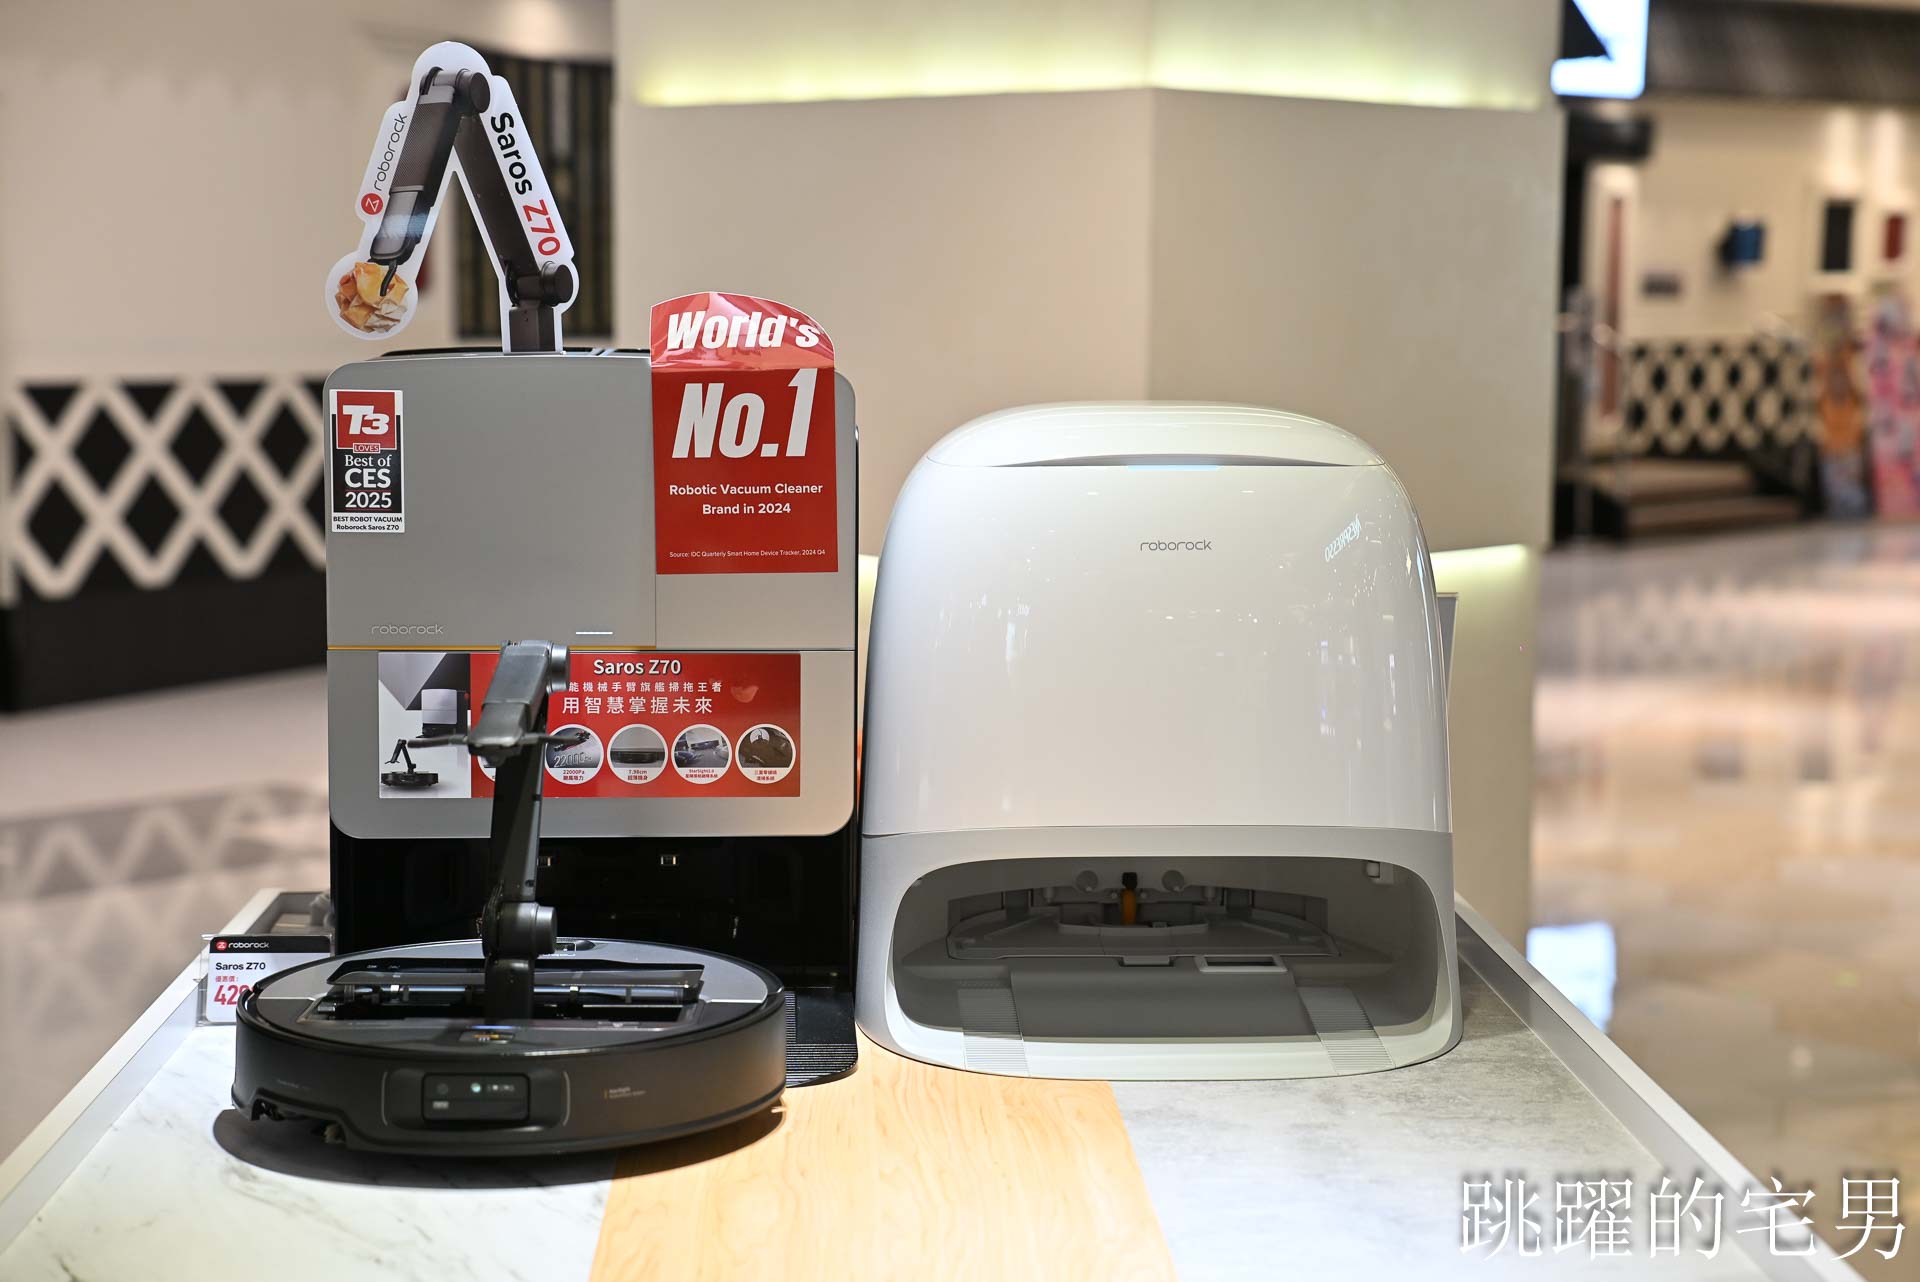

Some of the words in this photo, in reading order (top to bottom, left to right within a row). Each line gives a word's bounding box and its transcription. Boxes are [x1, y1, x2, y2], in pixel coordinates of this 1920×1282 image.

[374, 112, 408, 191] roborock
[490, 112, 533, 195] Saros
[522, 199, 561, 257] Z70
[667, 311, 820, 350] World's
[342, 404, 390, 435] T3
[671, 368, 818, 459] No.1
[354, 444, 379, 452] LOVES
[344, 454, 374, 467] Best
[377, 454, 393, 467] of
[344, 468, 392, 489] CES
[669, 484, 717, 496] Robotic
[720, 484, 771, 495] Vacuum
[774, 483, 823, 494] Cleaner
[345, 491, 392, 509] 2025
[702, 504, 740, 515] Brand
[743, 503, 754, 514] in
[758, 503, 791, 514] 2024
[1141, 539, 1212, 551] roborock
[701, 550, 727, 559] Quarterly
[371, 623, 444, 635] roborock
[593, 659, 645, 675] Saros
[648, 659, 682, 675] Z70
[562, 696, 712, 715] 用智慧掌握未來
[228, 941, 270, 949] roborock
[215, 962, 244, 970] Saros
[246, 962, 266, 970] Z70
